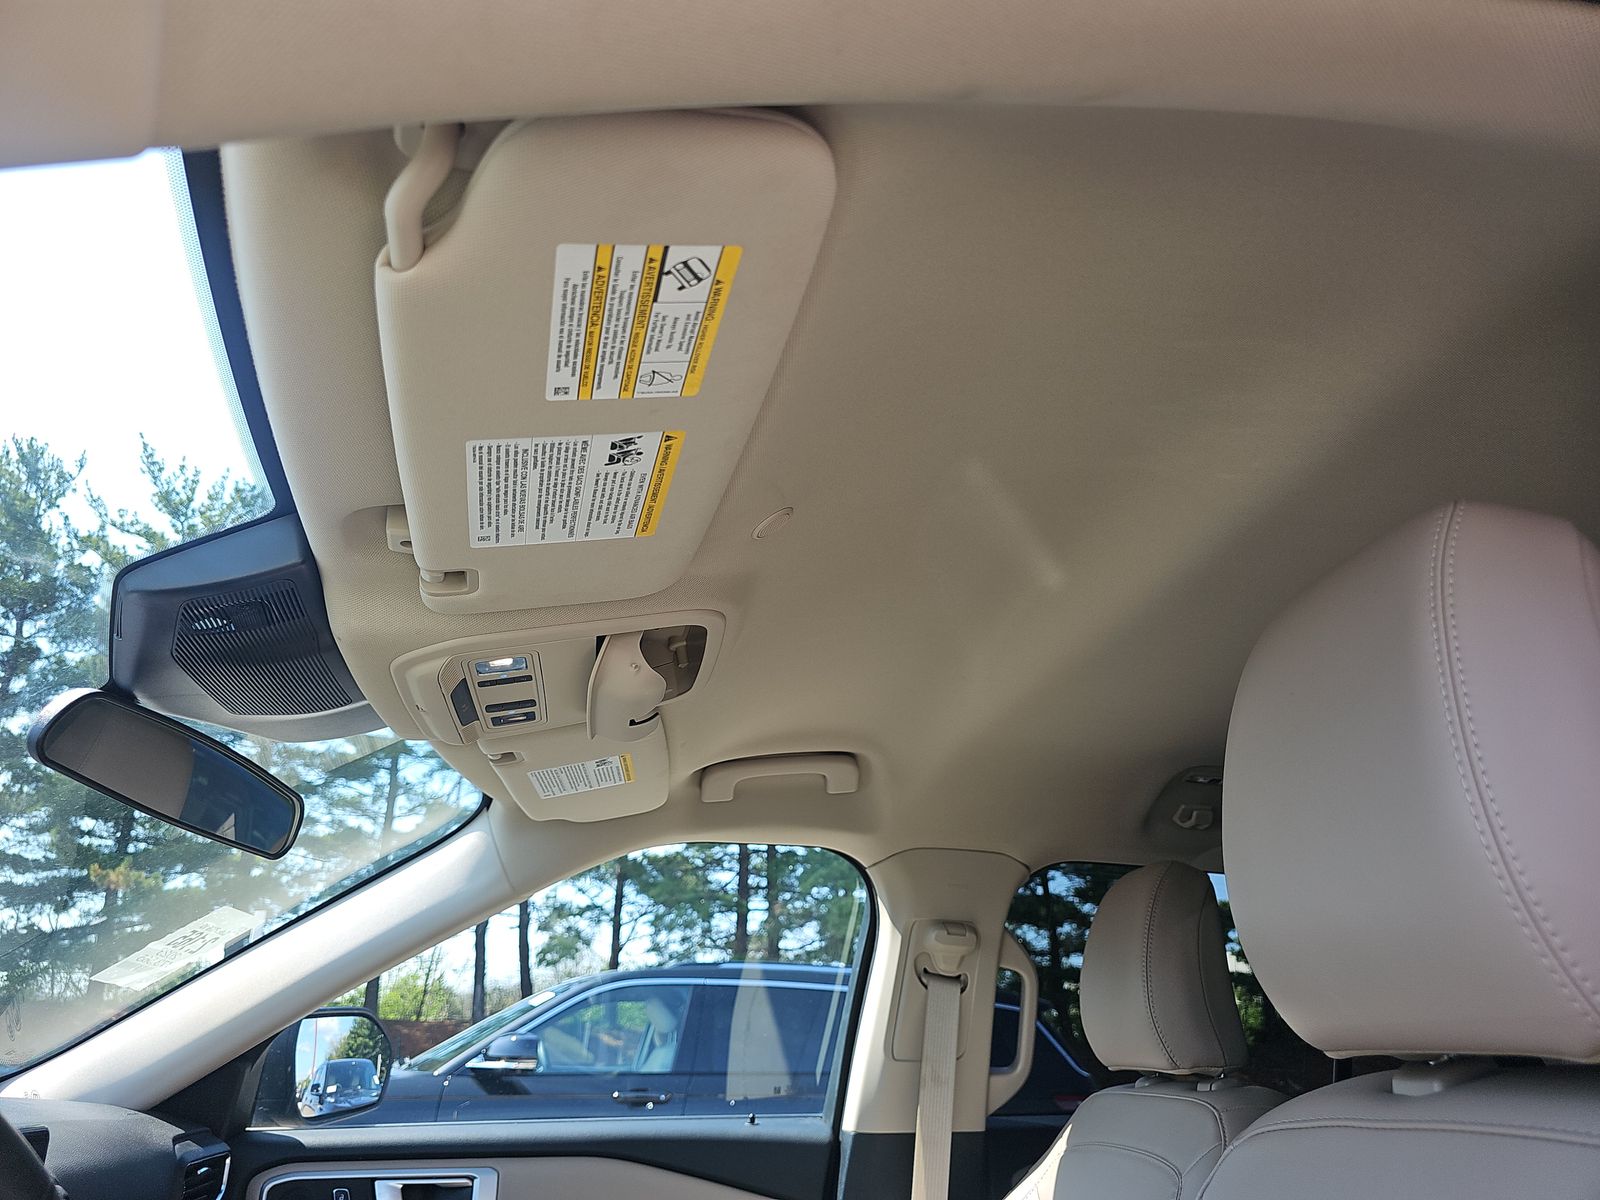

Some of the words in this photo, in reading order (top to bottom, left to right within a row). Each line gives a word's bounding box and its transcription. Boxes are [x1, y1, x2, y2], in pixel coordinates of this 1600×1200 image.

[590, 274, 605, 329] ADVERTENCIA:
[637, 265, 658, 330] AVERTISSEMENT:
[706, 287, 723, 322] WARNING:
